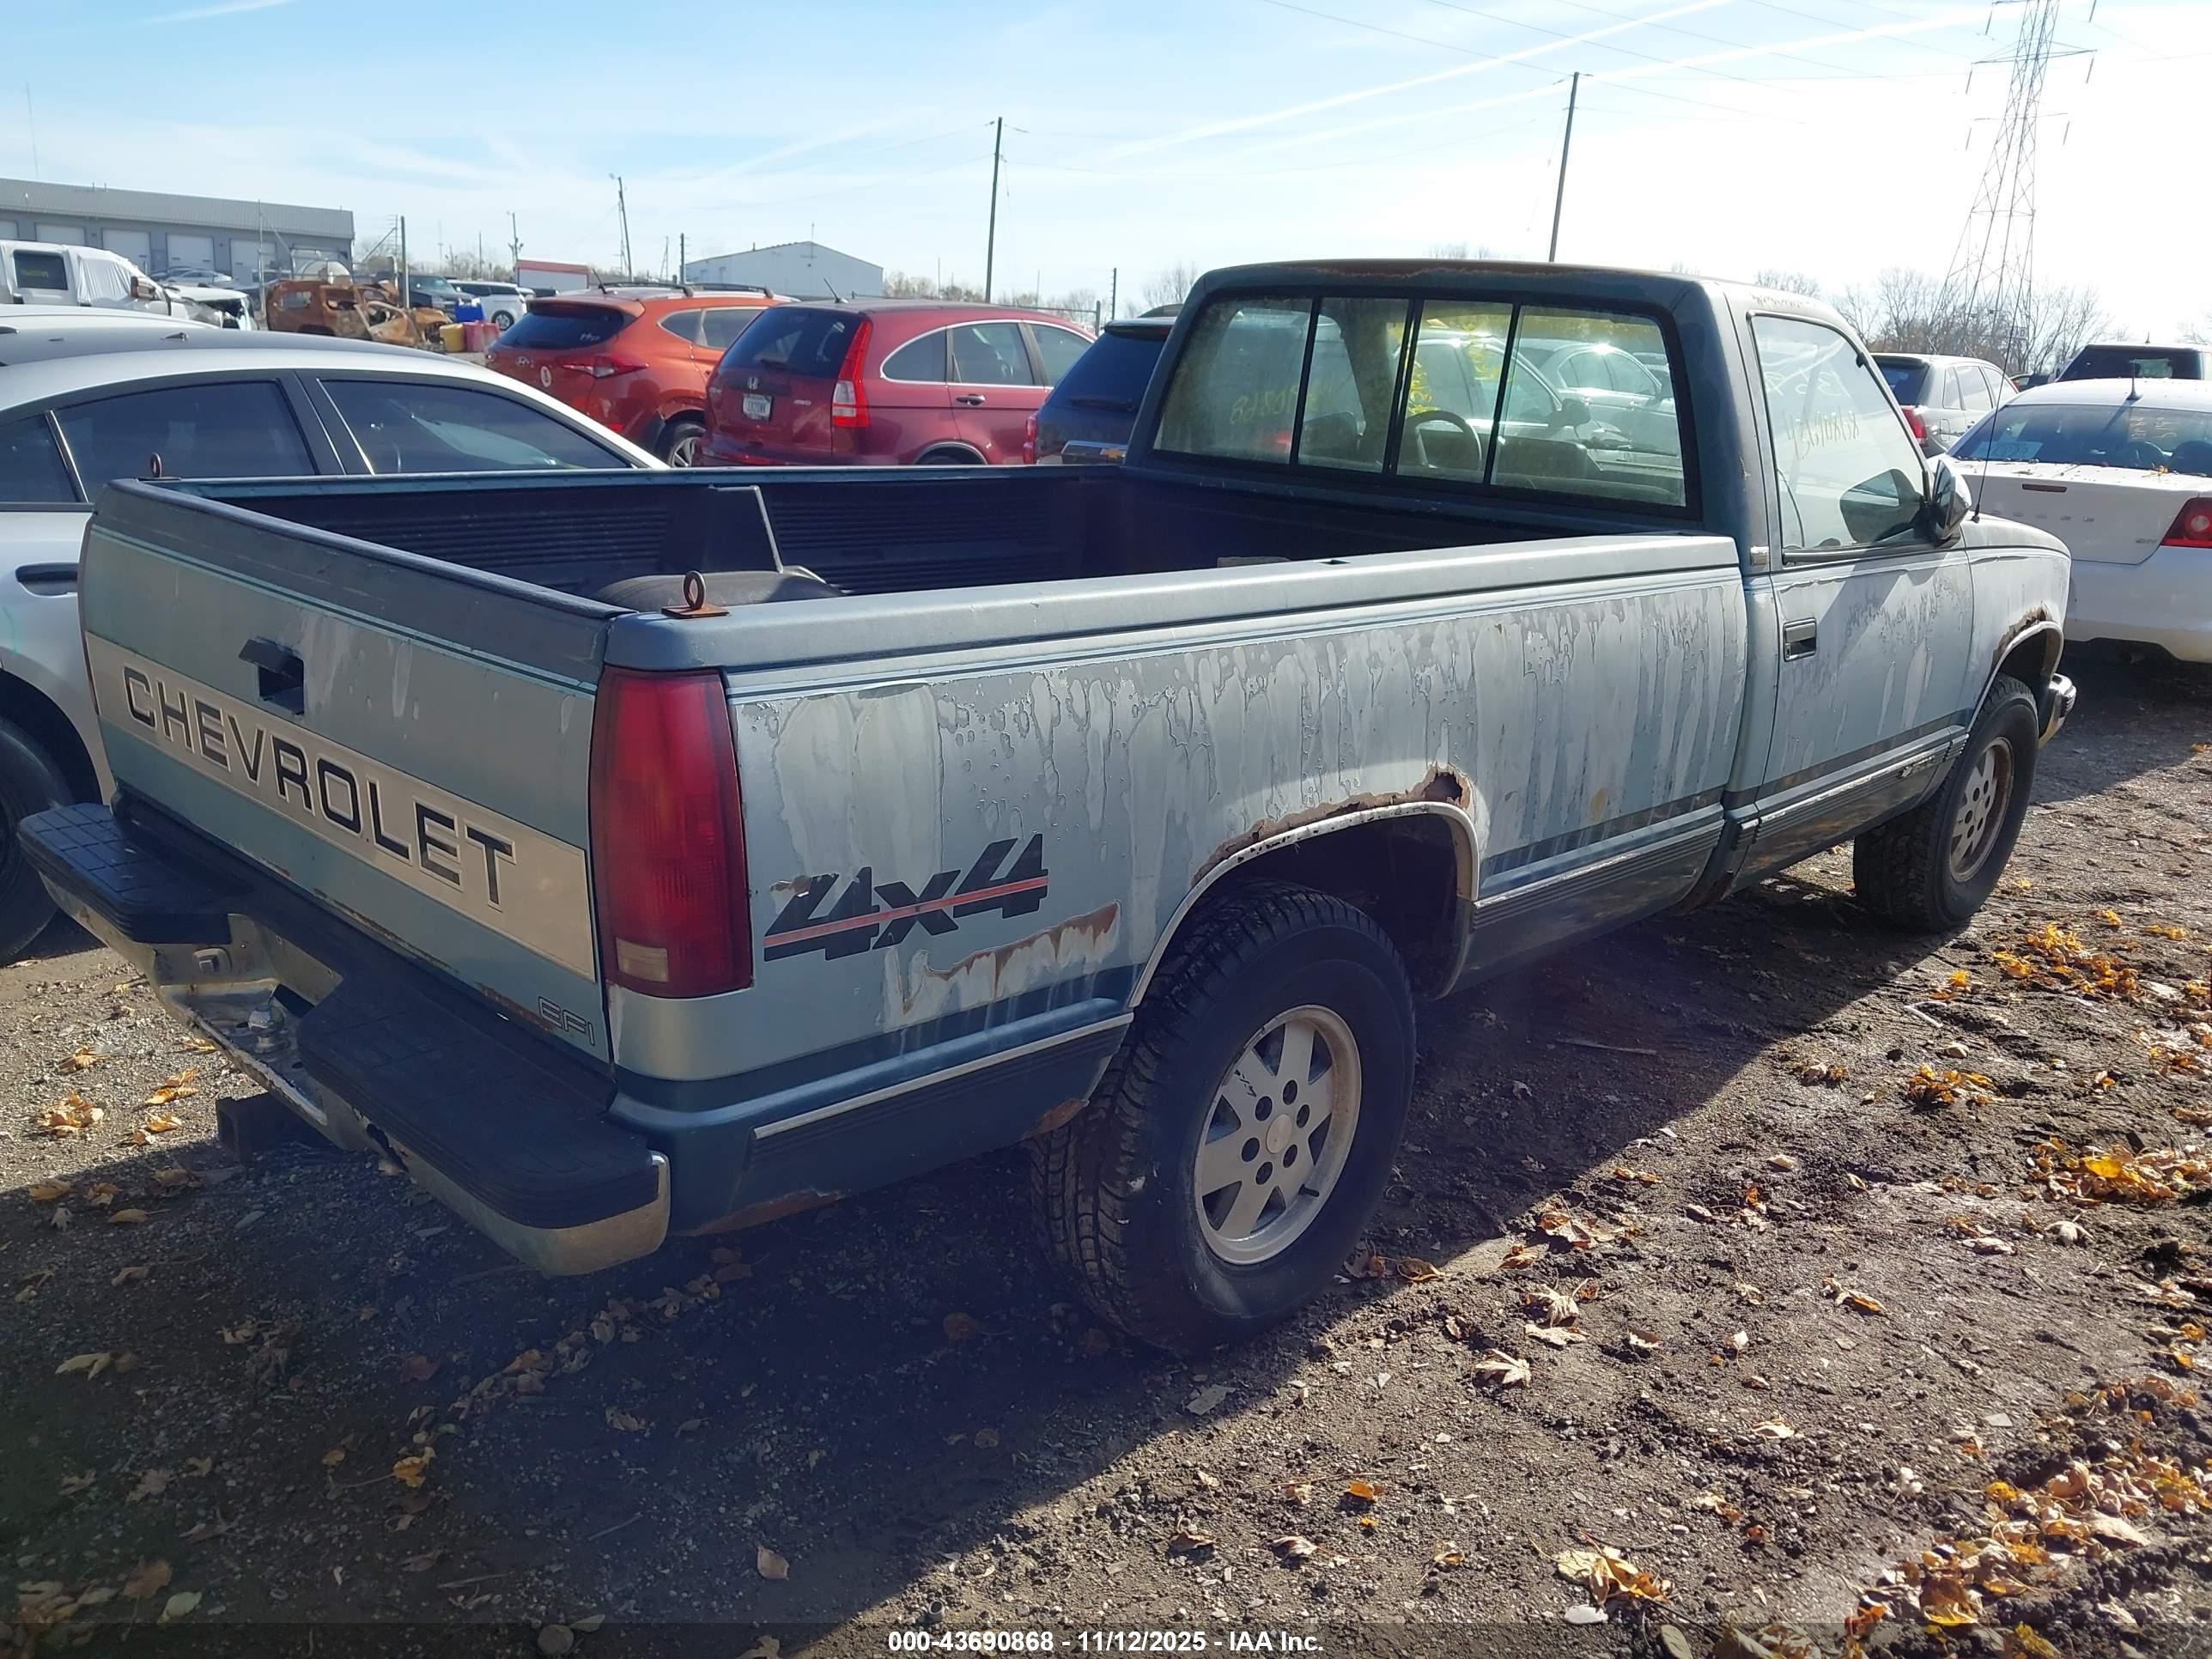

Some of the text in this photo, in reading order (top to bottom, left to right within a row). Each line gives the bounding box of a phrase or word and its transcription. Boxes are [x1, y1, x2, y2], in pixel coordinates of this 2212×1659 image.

[123, 665, 516, 911] CHEVROLET
[763, 834, 1048, 961] 4x4
[538, 996, 595, 1046] EFI
